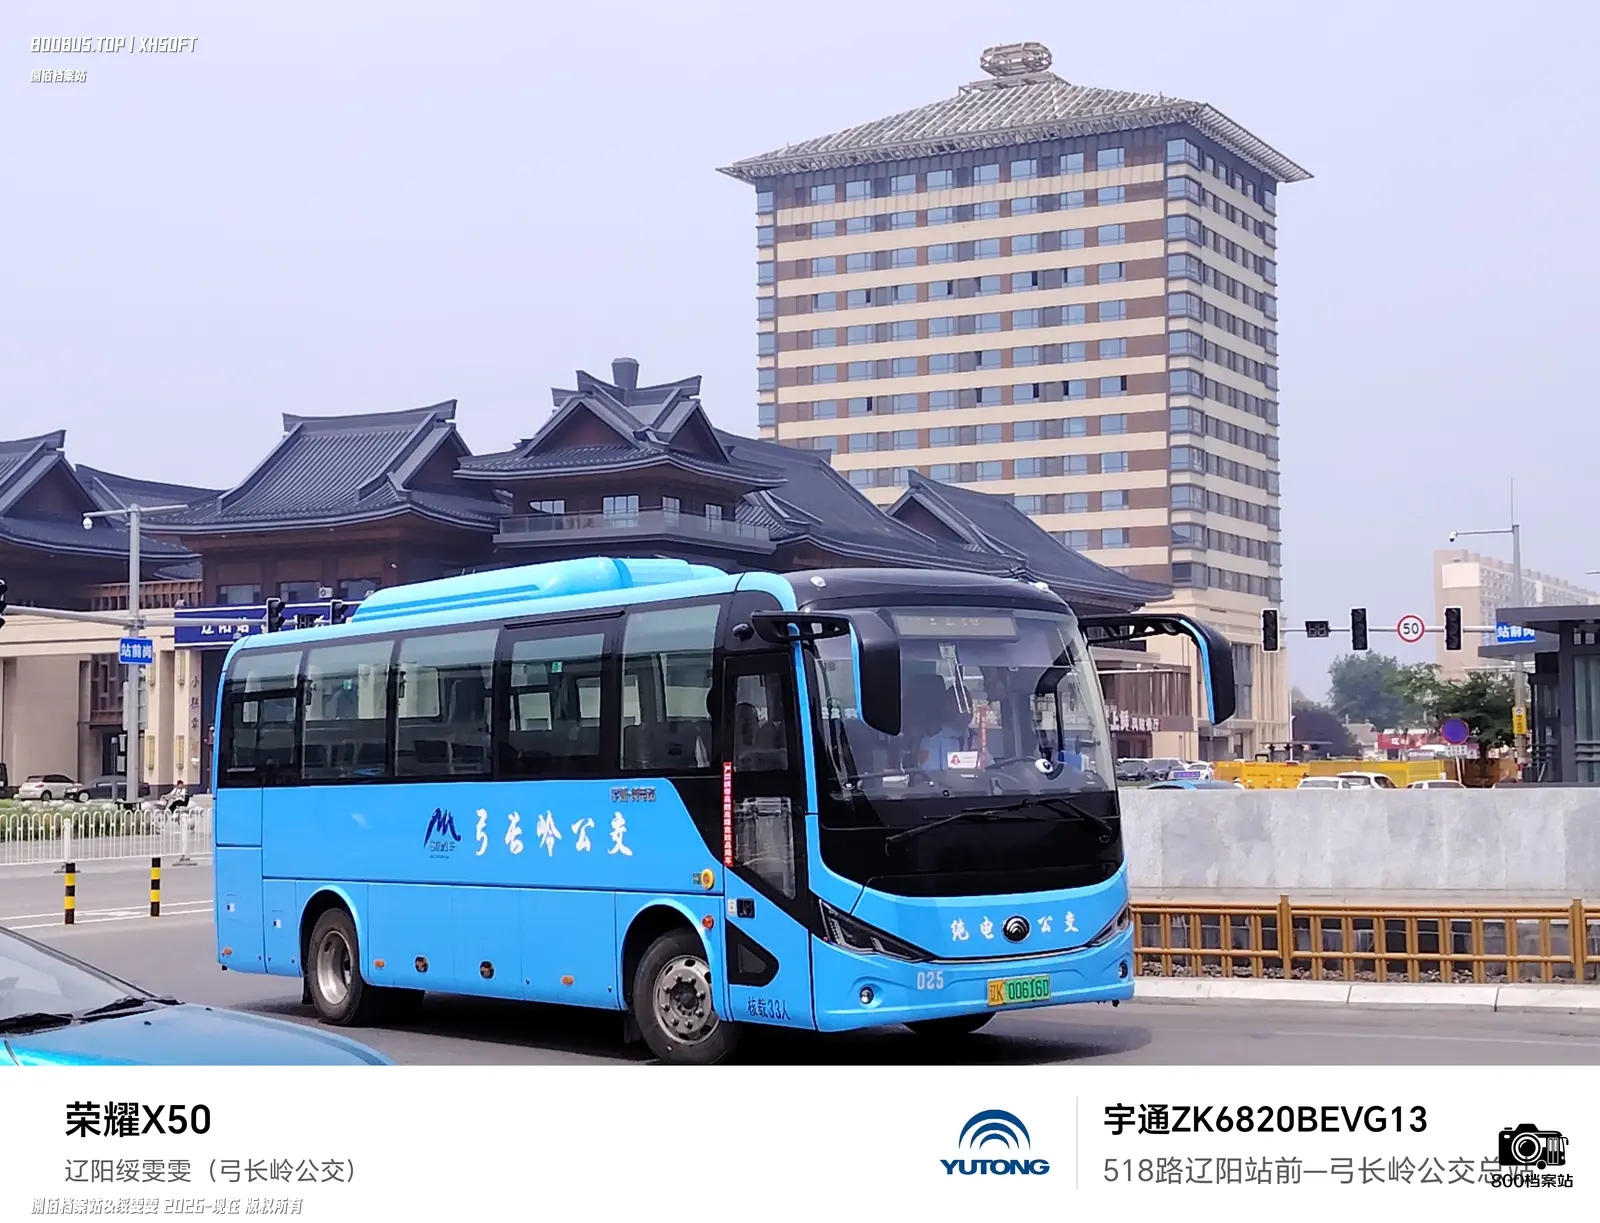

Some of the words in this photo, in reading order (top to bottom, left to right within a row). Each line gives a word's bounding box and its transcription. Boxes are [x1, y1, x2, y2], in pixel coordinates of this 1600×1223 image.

[1402, 622, 1420, 636] 50
[120, 642, 152, 659] 站前岗
[475, 808, 634, 857] 弓长岭公交
[1037, 911, 1079, 933] 公交
[916, 971, 944, 990] 025
[747, 997, 792, 1021] 核载33人
